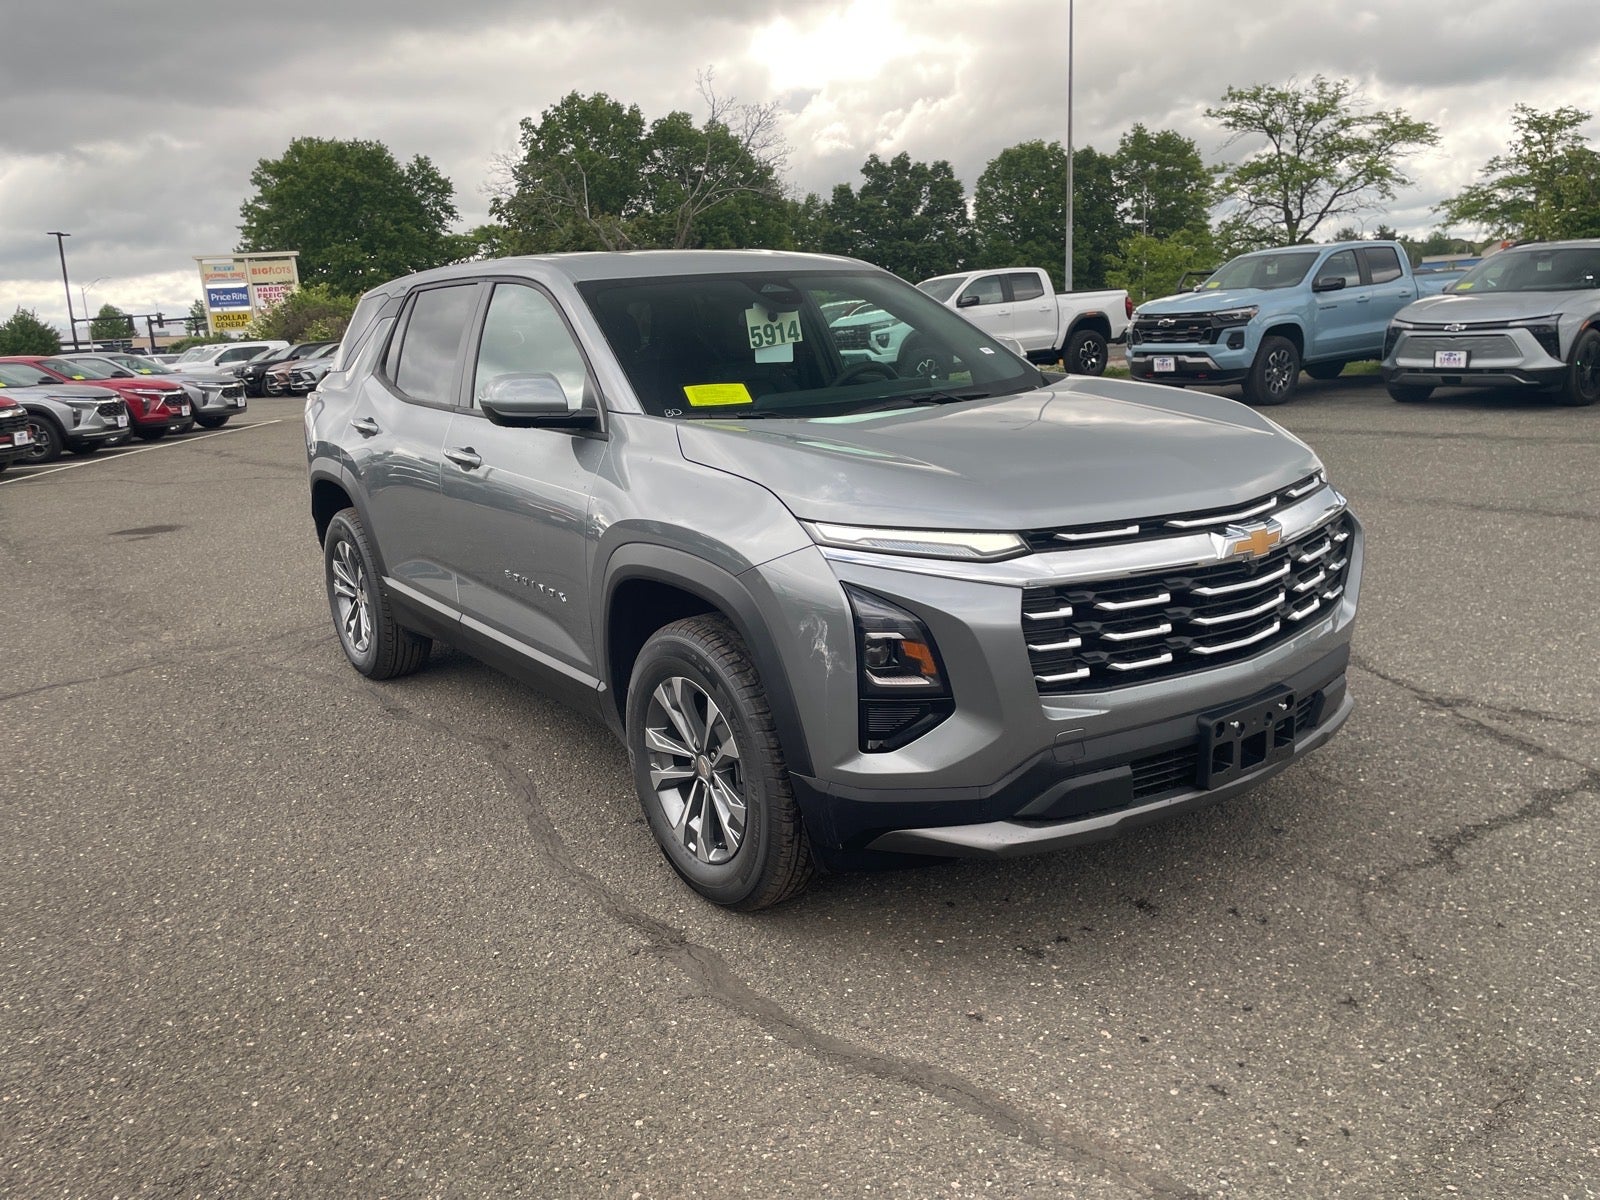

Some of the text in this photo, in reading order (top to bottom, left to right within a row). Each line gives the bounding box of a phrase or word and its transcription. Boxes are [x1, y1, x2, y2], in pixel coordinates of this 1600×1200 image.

[251, 267, 268, 275] BIG
[210, 291, 248, 301] Price Rite
[215, 313, 248, 321] DOLLAR
[215, 321, 246, 329] GENERA
[750, 320, 801, 348] 5914
